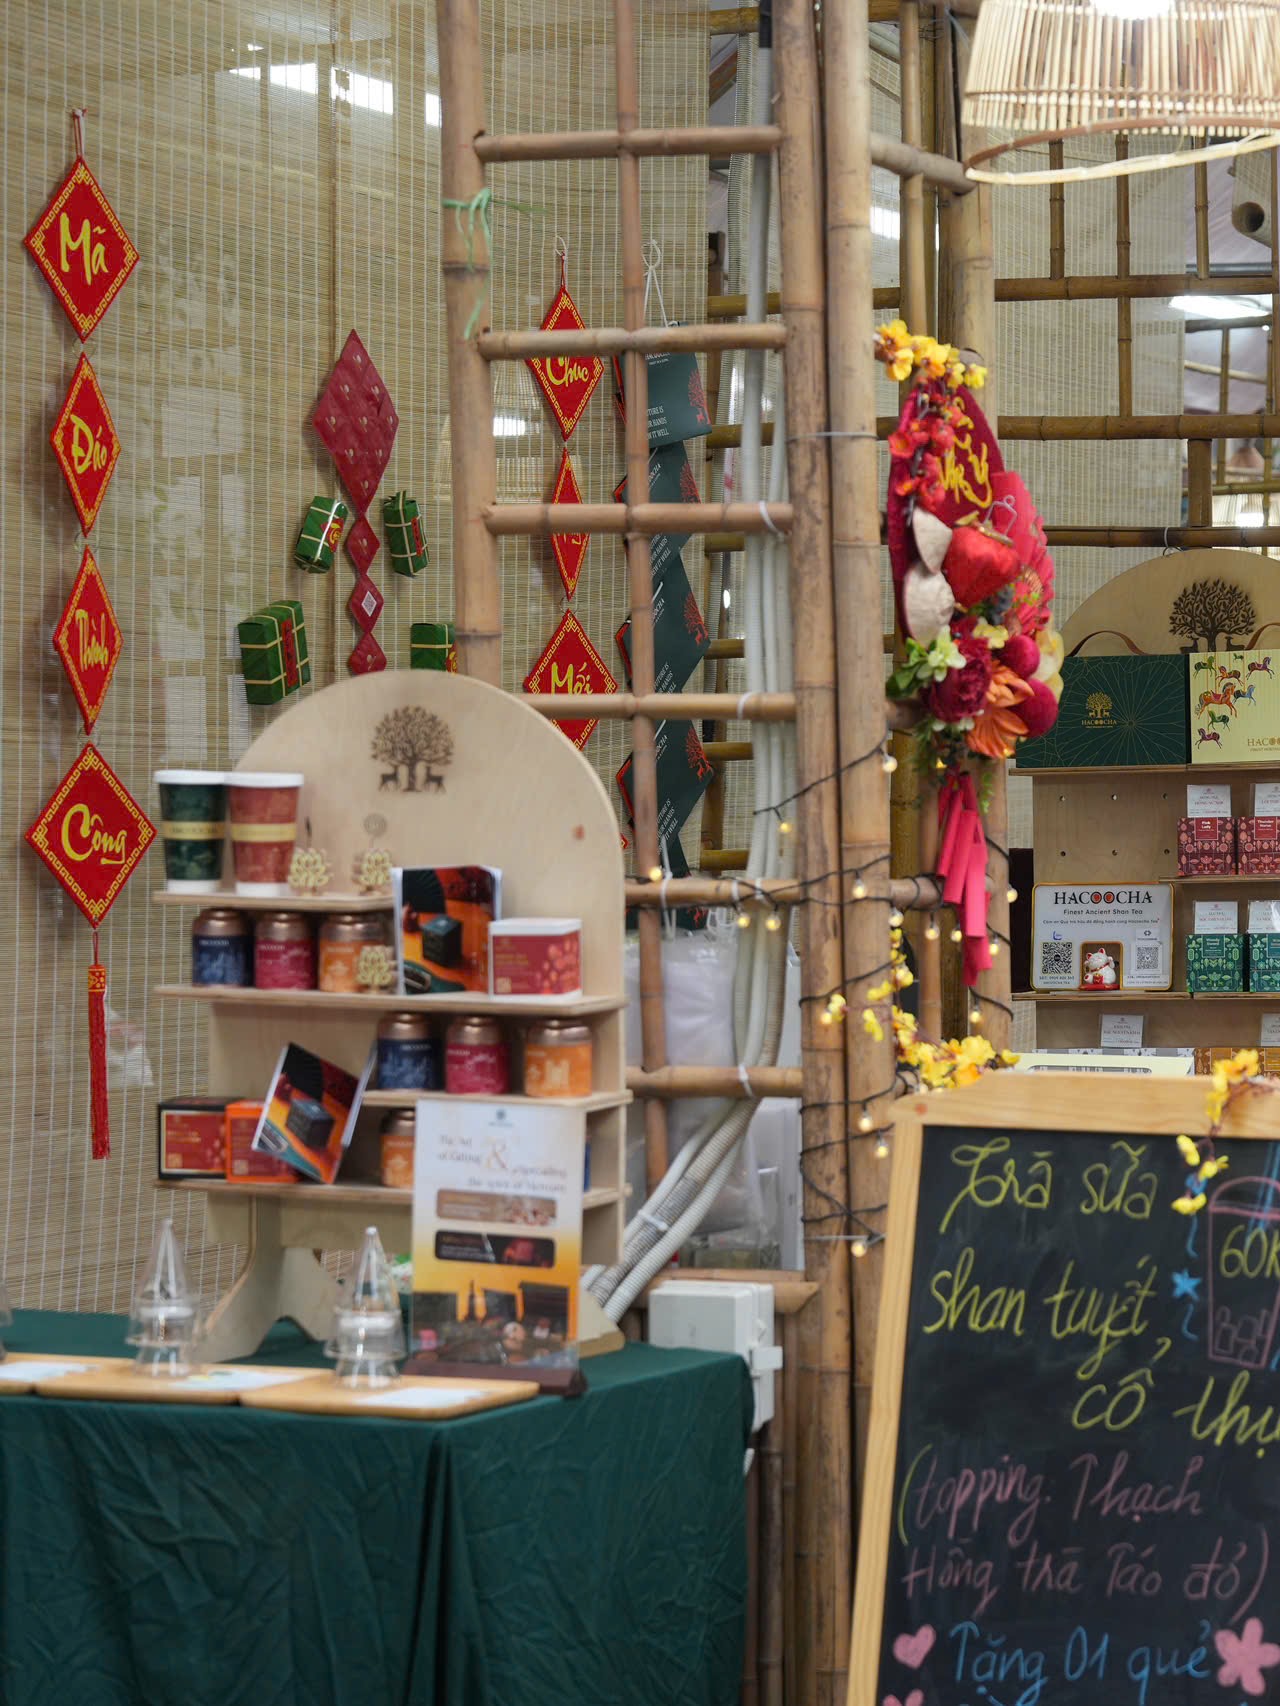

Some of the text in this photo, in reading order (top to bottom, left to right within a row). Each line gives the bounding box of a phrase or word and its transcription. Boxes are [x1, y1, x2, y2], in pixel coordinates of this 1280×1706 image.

[59, 212, 109, 286] Mã
[69, 413, 108, 475] Đáo
[61, 803, 128, 866] Công
[1054, 890, 1153, 905] HACOOCHA
[1080, 1140, 1158, 1219] sữa
[1069, 1450, 1205, 1524] Thạch
[1064, 1625, 1110, 1681] 01
